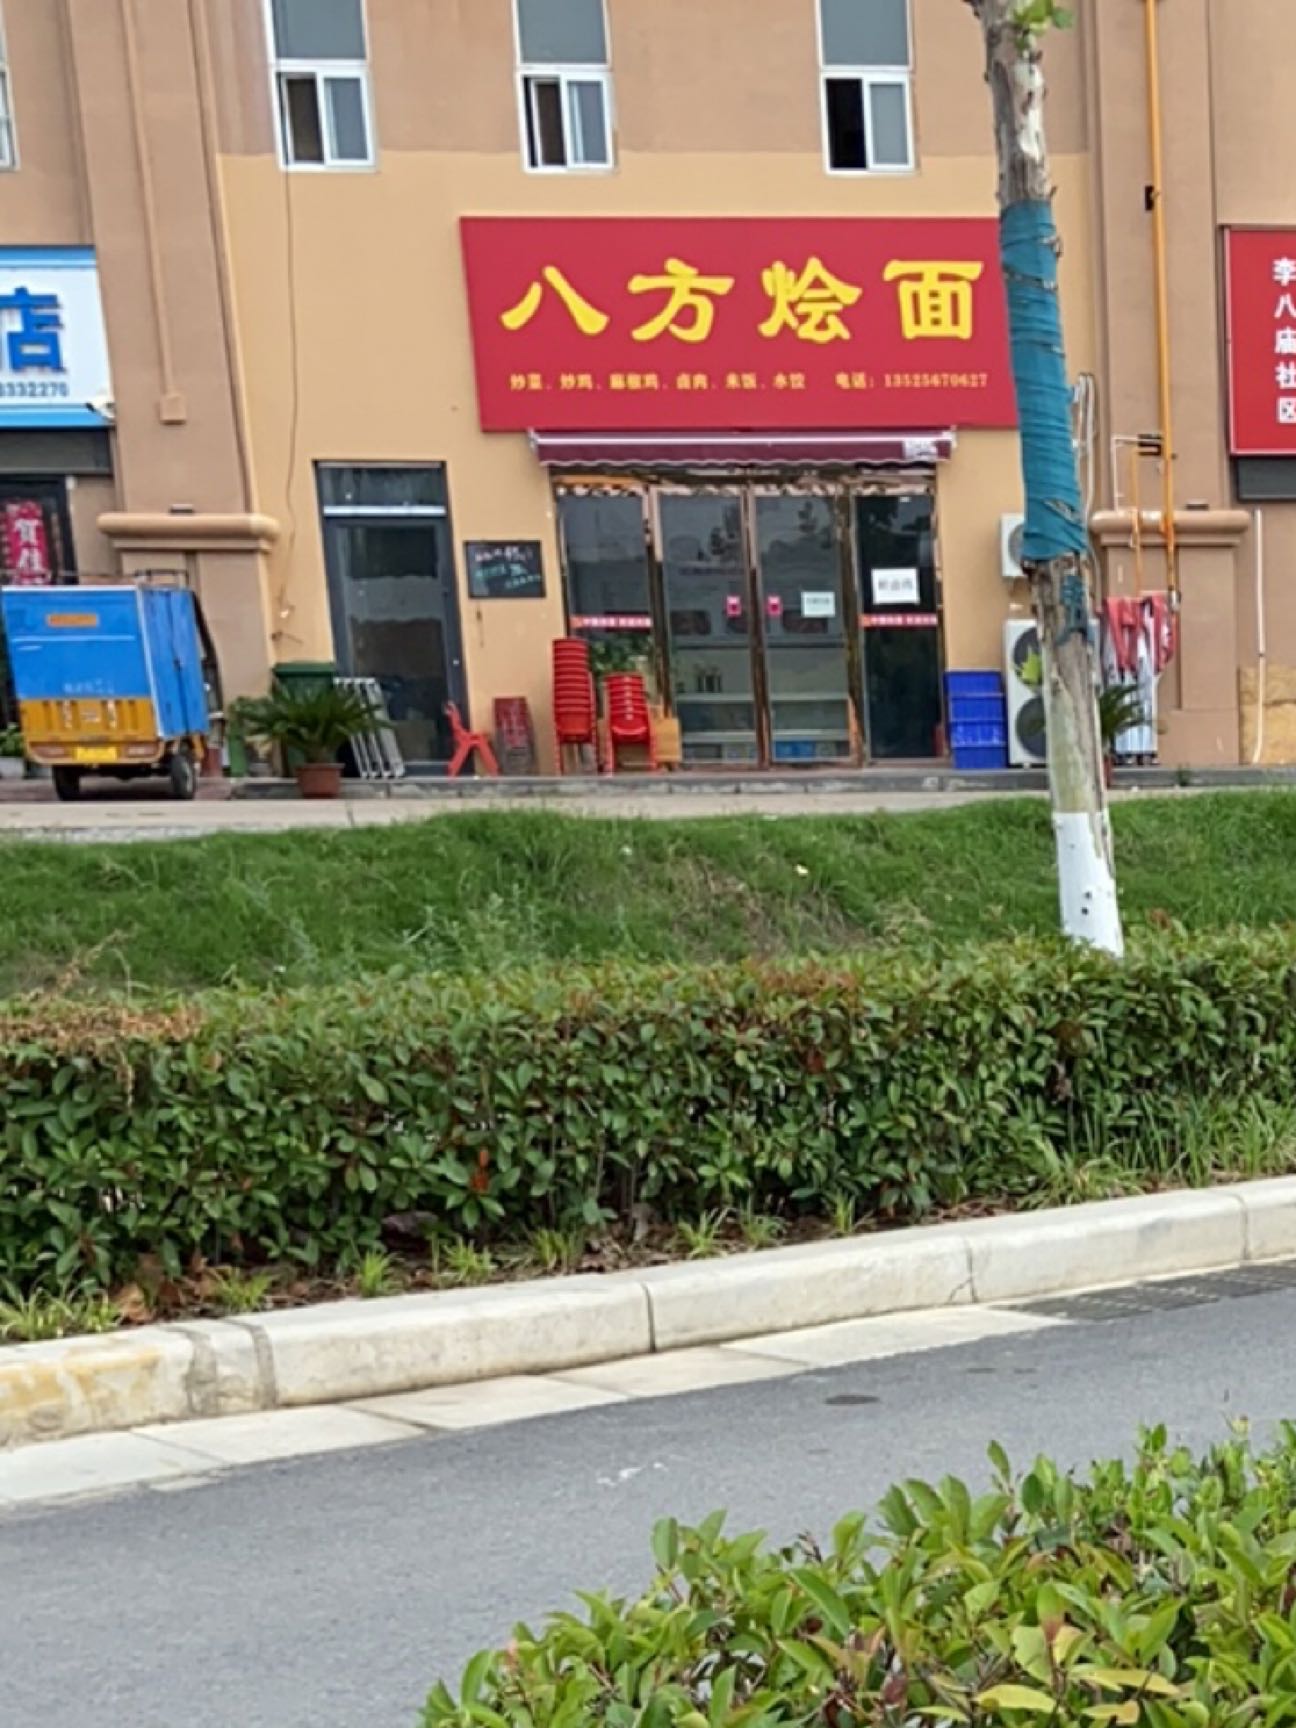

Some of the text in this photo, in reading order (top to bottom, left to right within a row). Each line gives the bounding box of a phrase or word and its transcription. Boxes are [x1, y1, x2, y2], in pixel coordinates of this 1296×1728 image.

[0, 286, 64, 374] 店
[501, 257, 983, 343] 八方烩面
